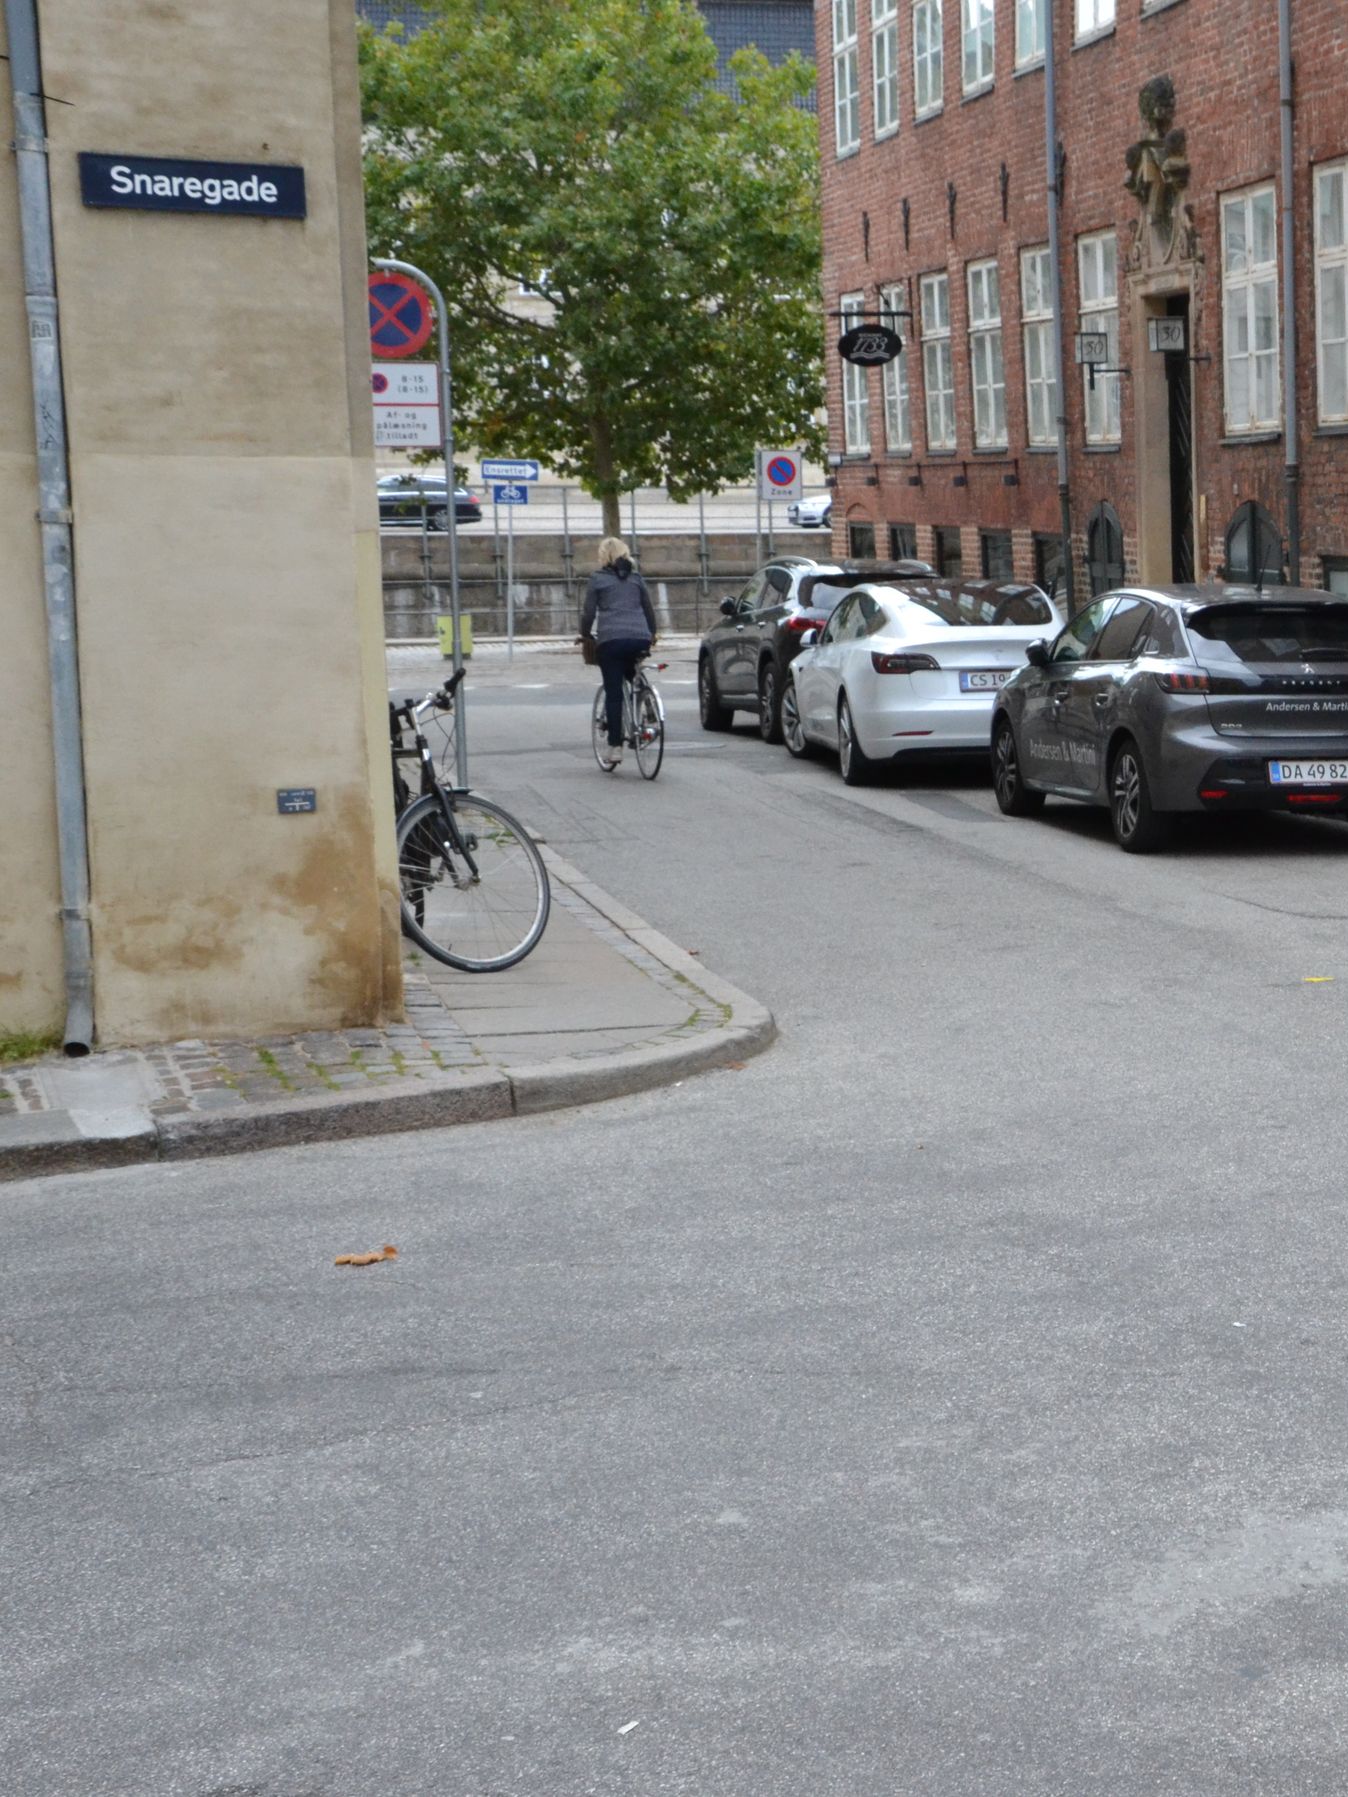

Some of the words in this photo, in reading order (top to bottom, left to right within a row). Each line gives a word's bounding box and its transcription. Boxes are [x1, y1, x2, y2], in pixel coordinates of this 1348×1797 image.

[110, 165, 278, 205] Snaregade
[969, 674, 988, 687] CS
[1266, 702, 1310, 712] Andersen
[1312, 703, 1320, 712] &
[1282, 764, 1303, 779] DA
[1307, 764, 1325, 779] 49
